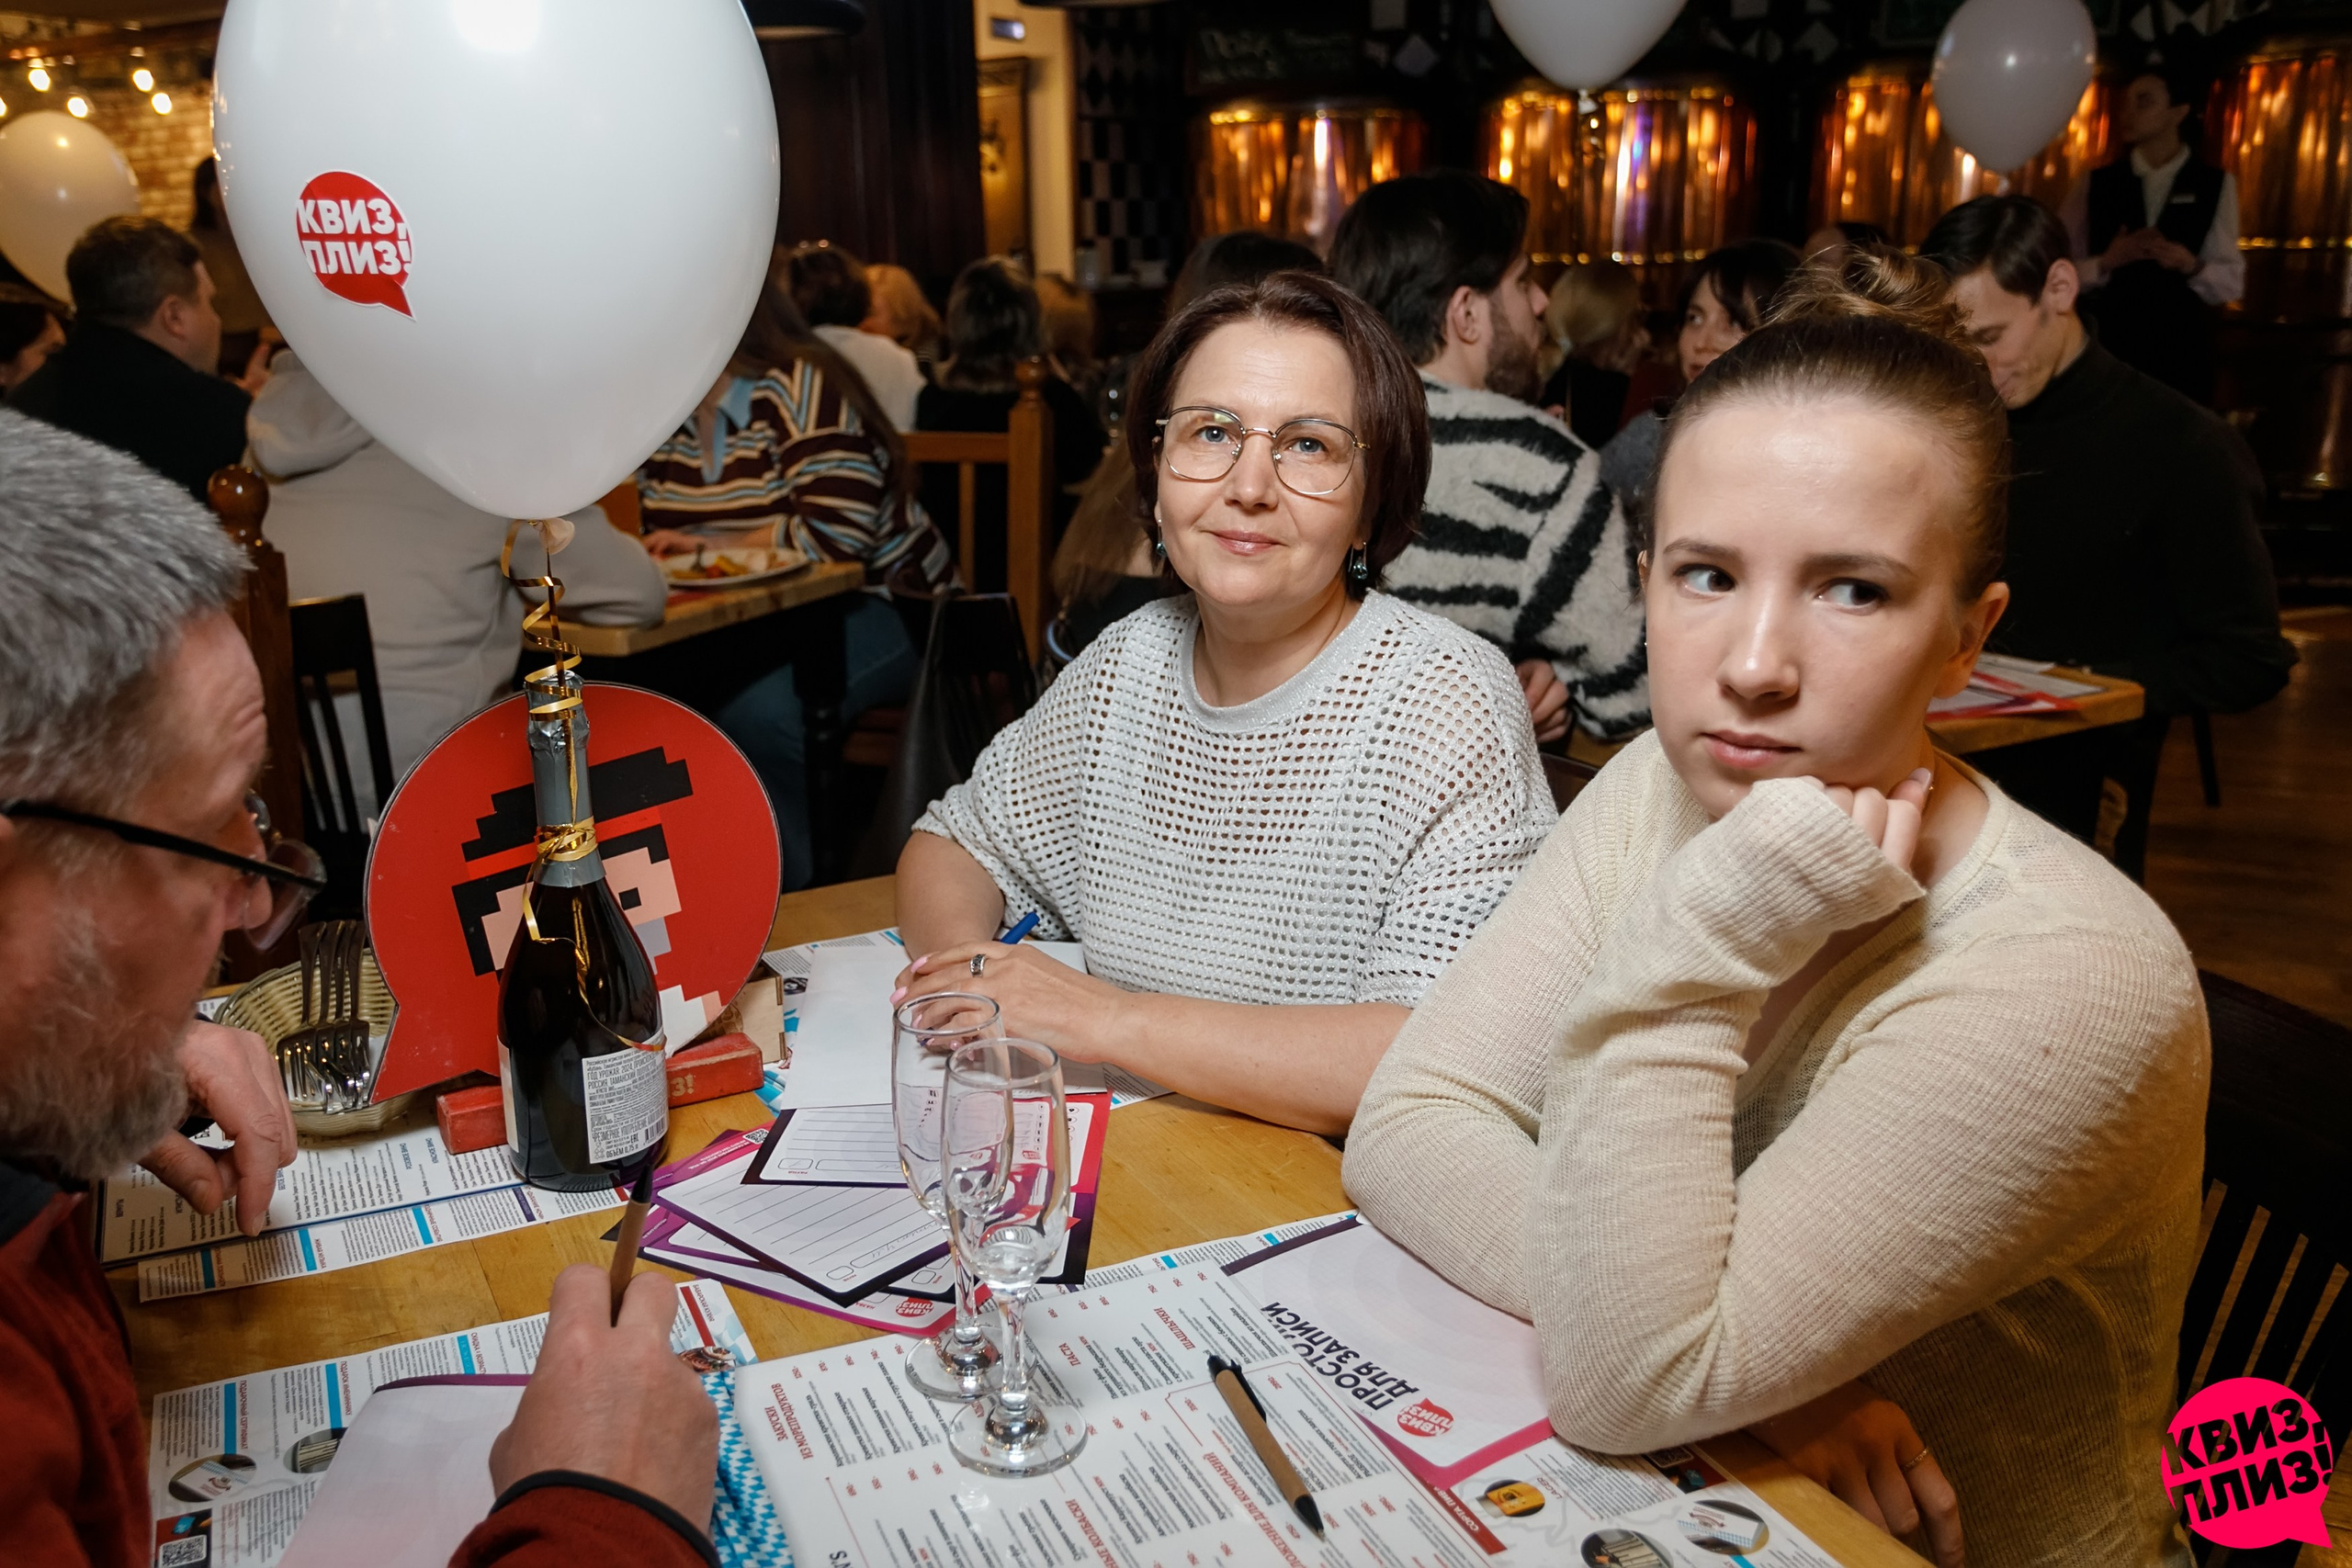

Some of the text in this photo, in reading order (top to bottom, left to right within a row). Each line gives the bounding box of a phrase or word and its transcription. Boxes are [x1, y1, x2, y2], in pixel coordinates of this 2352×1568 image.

[301, 241, 413, 276] ПЛИЗ!
[1152, 1306, 1196, 1350] ШАШЛЫЧКИ
[1204, 1314, 1227, 1335] беконом
[1259, 1299, 1362, 1367] ЗАПИСИ
[1056, 1342, 1081, 1366] ПАСТА
[1112, 1346, 1137, 1372] карбонара
[1137, 1345, 1153, 1359] паста
[1153, 1350, 1181, 1379] креветками
[1090, 1367, 1106, 1381] филе
[1102, 1367, 1125, 1390] куриного
[1148, 1359, 1174, 1385] Сливочная
[1290, 1340, 1394, 1410] ПРОСТО
[1351, 1358, 1419, 1402] ДЛЯ
[763, 1405, 789, 1441] ЗАКУСКИ
[769, 1382, 813, 1459] ИЗ МОРЕПРОДУКТОВ
[854, 1434, 874, 1460] Креветки
[882, 1427, 901, 1453] Креветки
[910, 1421, 930, 1447] Креветки
[1201, 1450, 1251, 1503] КОМПАНИЙ
[1339, 1456, 1363, 1480] Ассорти
[1346, 1452, 1374, 1478] РЫБНОЕ
[1534, 1476, 1563, 1499] LAGER
[1064, 1498, 1104, 1547] КОЛБАСКИ
[1241, 1500, 1267, 1522] ДЛЯ
